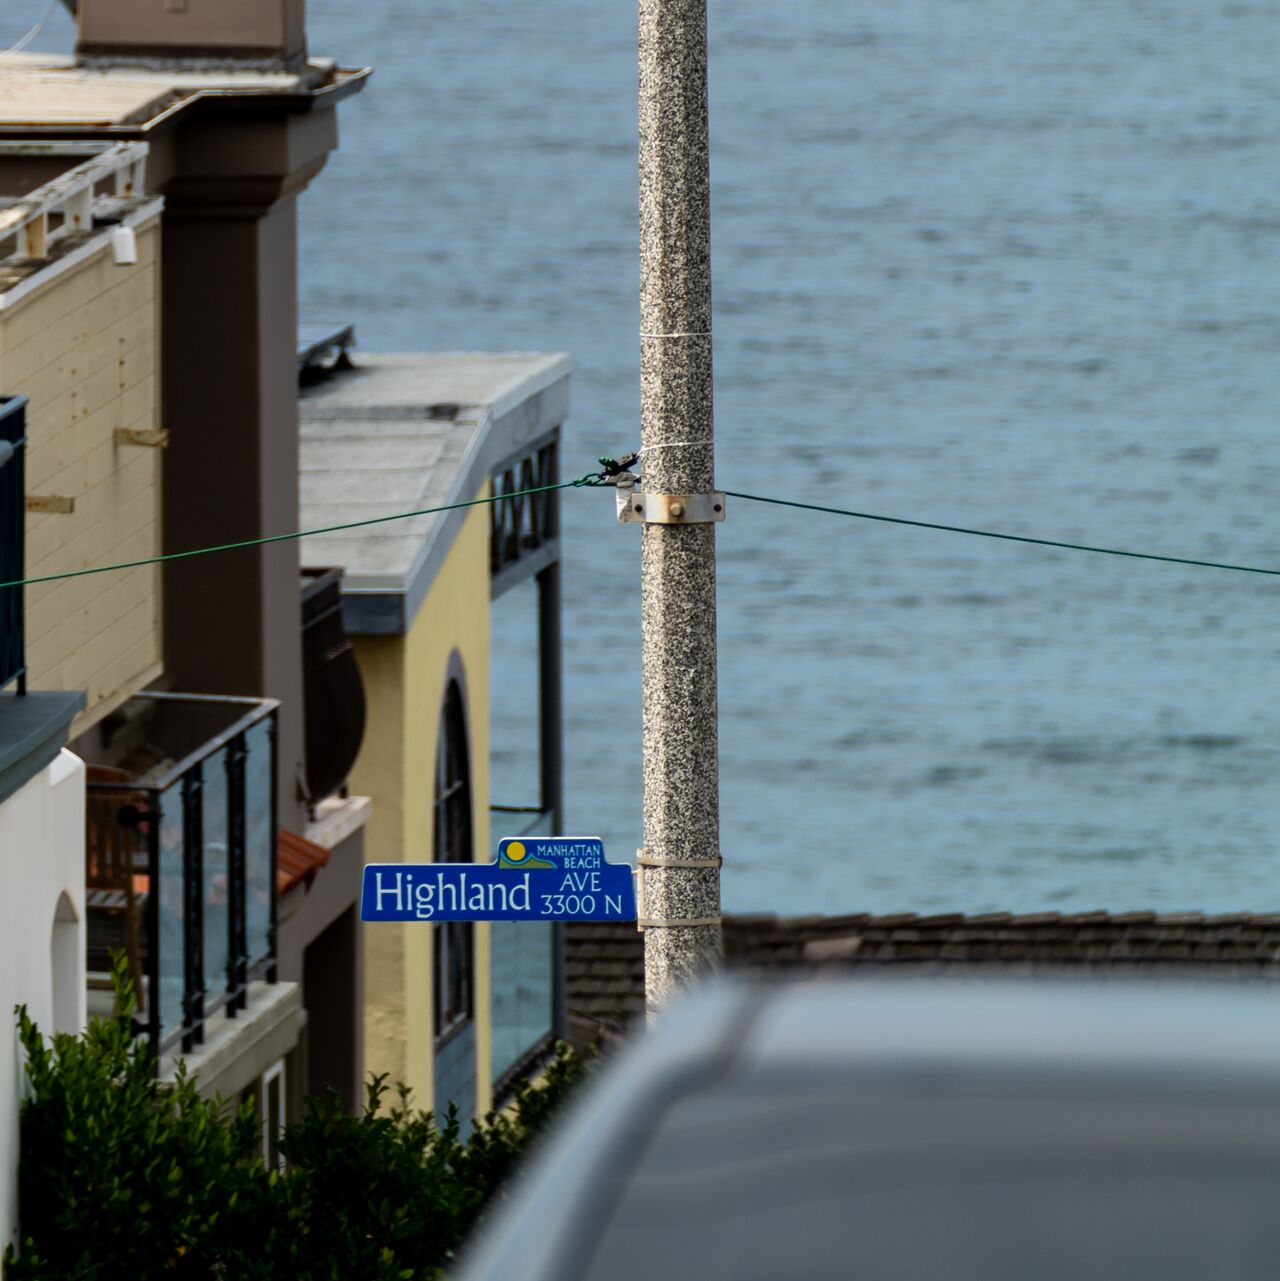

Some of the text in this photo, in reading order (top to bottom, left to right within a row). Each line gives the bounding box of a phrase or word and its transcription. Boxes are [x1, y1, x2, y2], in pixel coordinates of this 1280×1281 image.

[537, 844, 601, 856] MANHATTAN
[564, 856, 601, 869] BEACH
[559, 871, 602, 892] AVE
[375, 872, 532, 919] Highland
[540, 894, 623, 915] 3300 N
